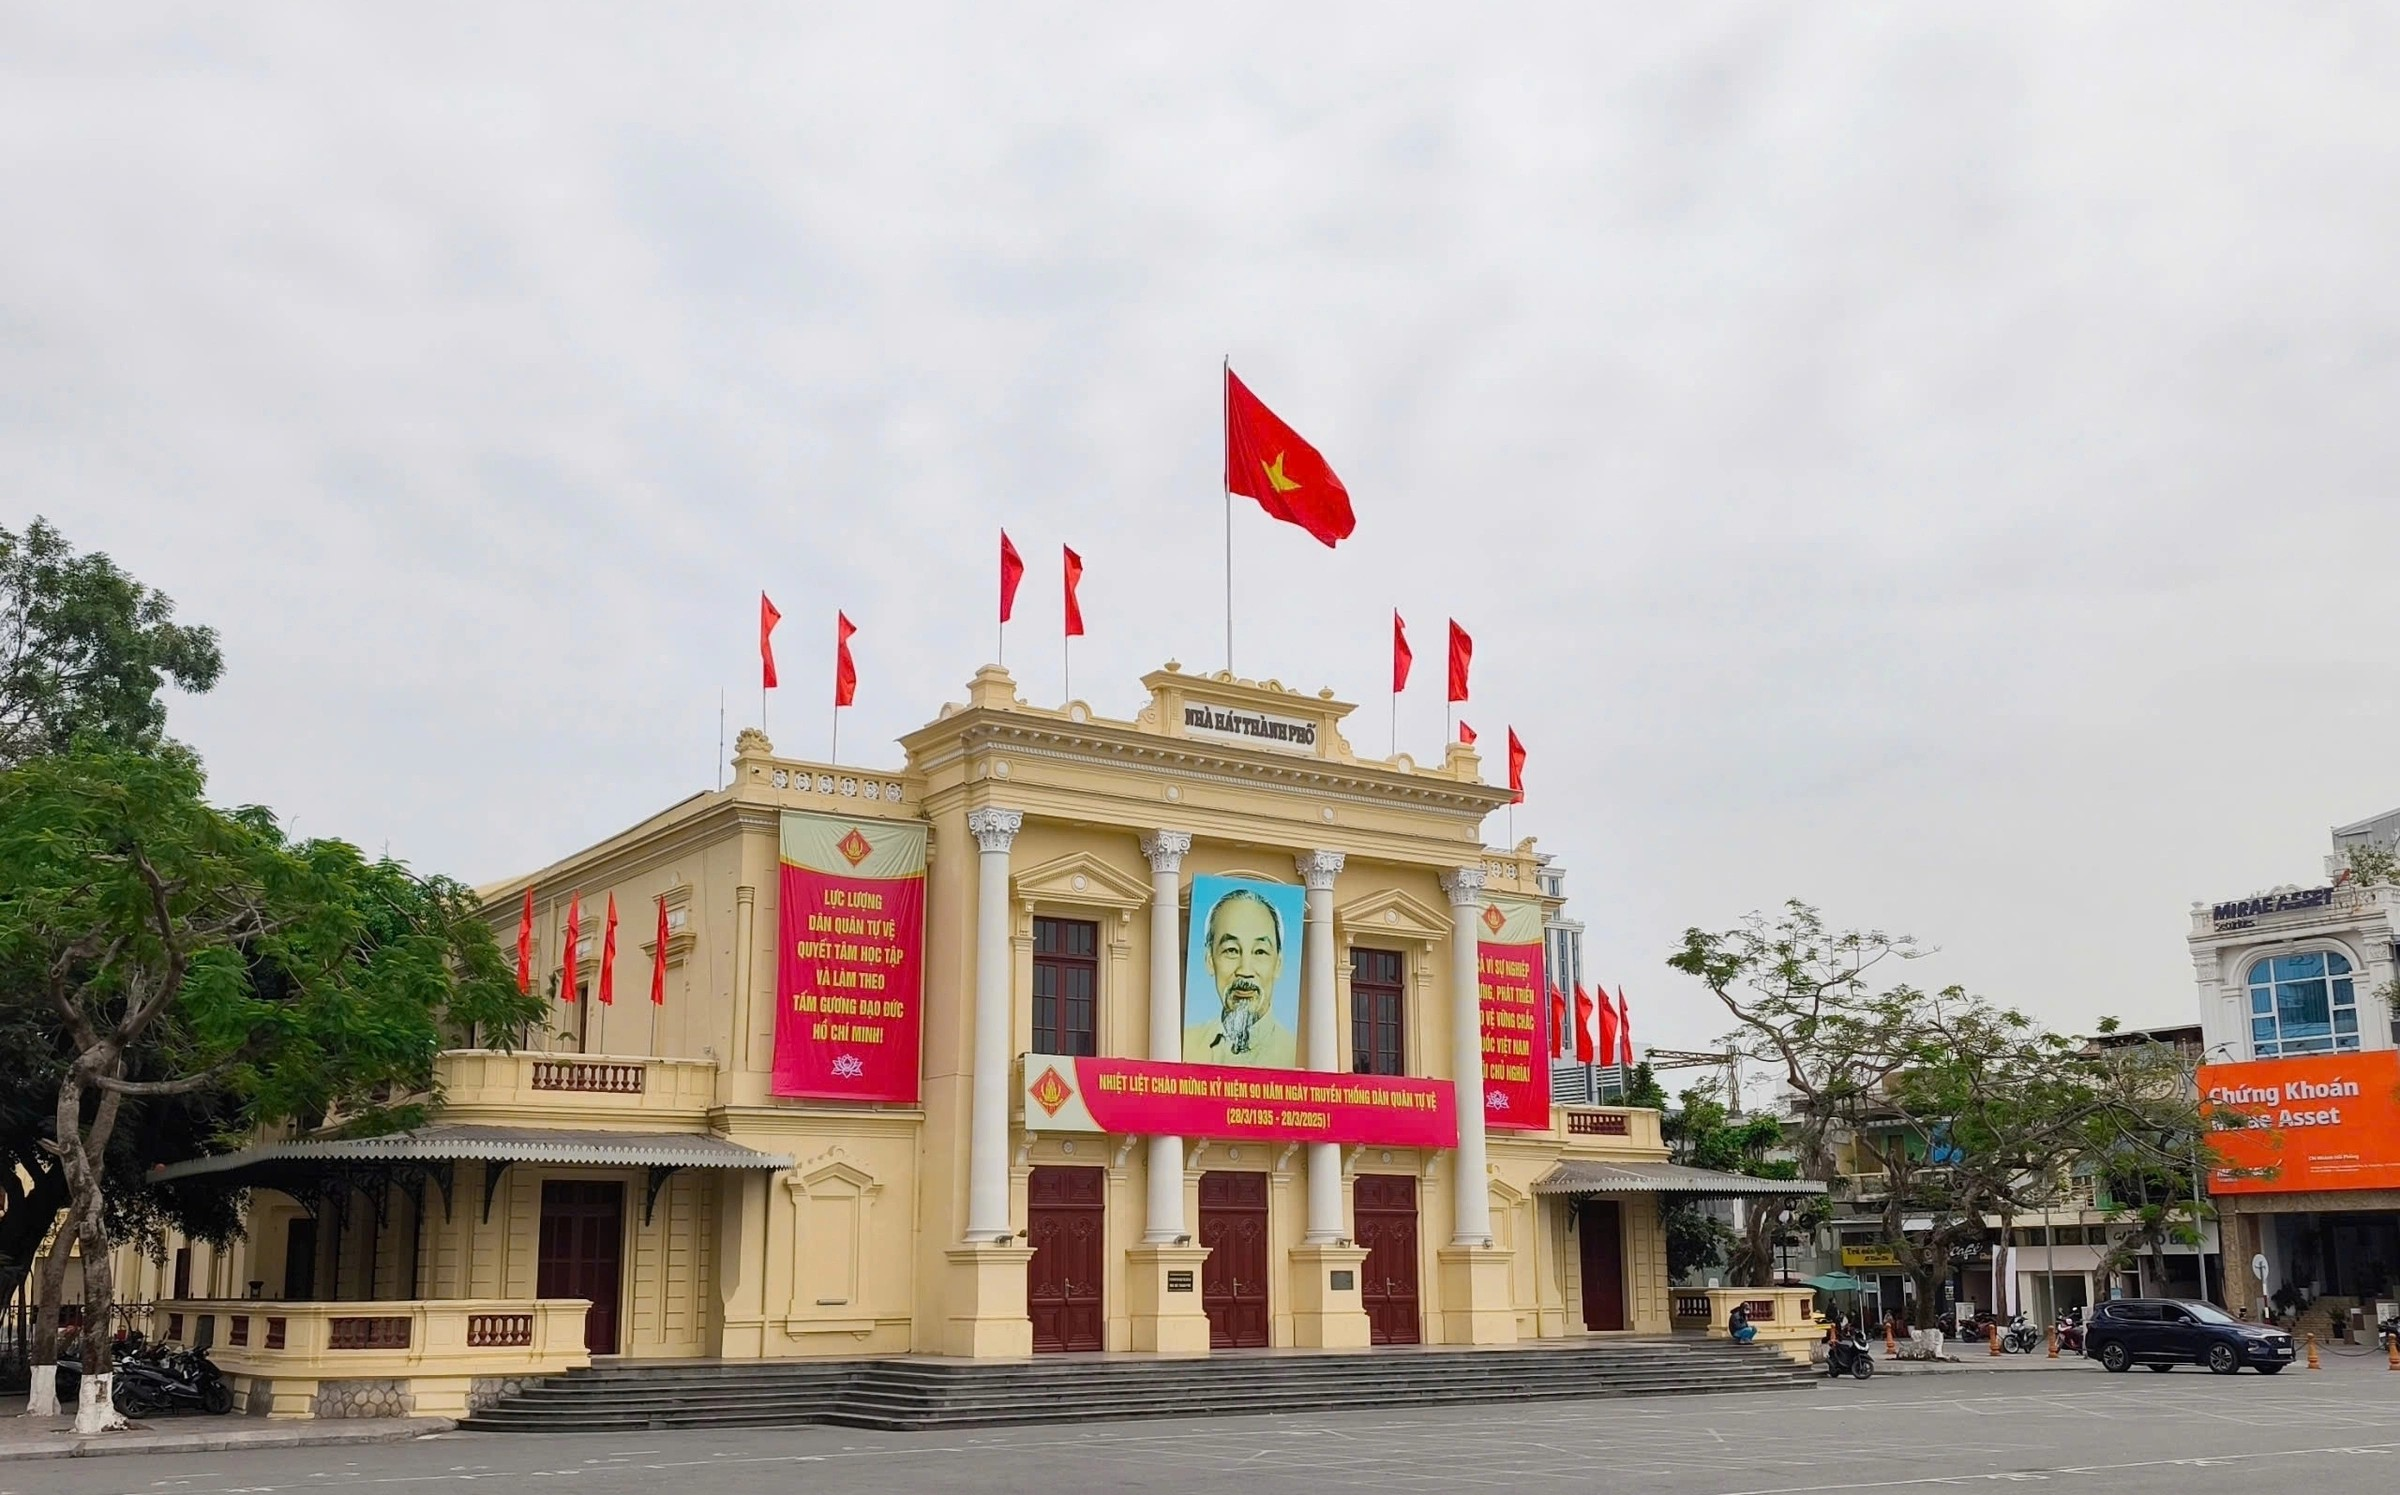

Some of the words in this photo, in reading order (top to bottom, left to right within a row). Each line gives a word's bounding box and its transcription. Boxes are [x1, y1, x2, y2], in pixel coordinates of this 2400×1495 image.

[1184, 706, 1214, 730] NHÀ
[1215, 710, 1242, 734] HÁT
[1243, 715, 1287, 741] THÀNH
[1289, 723, 1317, 746] PHỐ
[824, 888, 845, 909] LỰC
[847, 891, 882, 912] LƯỢNG
[2213, 898, 2274, 920] MIRAE
[808, 912, 832, 932] DÂN
[834, 915, 864, 935] QUÂN
[866, 919, 881, 940] TỰ
[882, 918, 896, 941] VỆ
[797, 938, 832, 959] QUYẾT
[834, 941, 858, 961] TÂM
[860, 945, 882, 966] HỌC
[884, 945, 904, 968] TẬP
[816, 966, 831, 986] VÀ
[832, 967, 857, 988] LÀM
[858, 972, 885, 990] THEO
[1486, 955, 1494, 974] VÌ
[1494, 958, 1505, 979] SỰ
[1505, 959, 1530, 981] NGHIỆP
[792, 989, 817, 1012] TẤM
[819, 996, 857, 1015] GƯƠNG
[859, 999, 881, 1019] ĐẠO
[883, 998, 904, 1018] ĐỨC
[1496, 982, 1514, 1002] PHÁT
[1515, 982, 1535, 1005] TRIỂN
[1485, 1007, 1495, 1030] VỆ
[1496, 1008, 1516, 1029] VỮNG
[1516, 1008, 1535, 1030] CHẮC
[812, 1018, 828, 1040] HỒ
[830, 1021, 850, 1041] CHÍ
[851, 1025, 884, 1044] MINH!
[1496, 1034, 1512, 1057] VIỆT
[1512, 1038, 1530, 1056] NAM
[1490, 1059, 1505, 1081] CHỦ
[1506, 1062, 1531, 1083] NGHĨA!
[1098, 1071, 1128, 1095] NHIỆT
[1129, 1071, 1150, 1096] LIỆT
[1151, 1074, 1177, 1095] CHÀO
[1179, 1076, 1208, 1096] MỪNG
[1209, 1075, 1222, 1097] KỶ
[1223, 1078, 1248, 1102] NIỆM
[1249, 1083, 1261, 1100] 90
[1262, 1080, 1284, 1100] NĂM
[1285, 1082, 1309, 1102] NGÀY
[1343, 1083, 1371, 1105] THỐNG
[1371, 1087, 1390, 1106] DÂN
[1390, 1089, 1413, 1109] QUÂN
[1414, 1091, 1426, 1112] TỰ
[1426, 1090, 1438, 1113] VỆ
[2208, 1083, 2280, 1107] Chứng
[2284, 1076, 2360, 1101] Khoán
[1226, 1107, 1274, 1126] (28/3/1935
[2279, 1106, 2341, 1128] Asset
